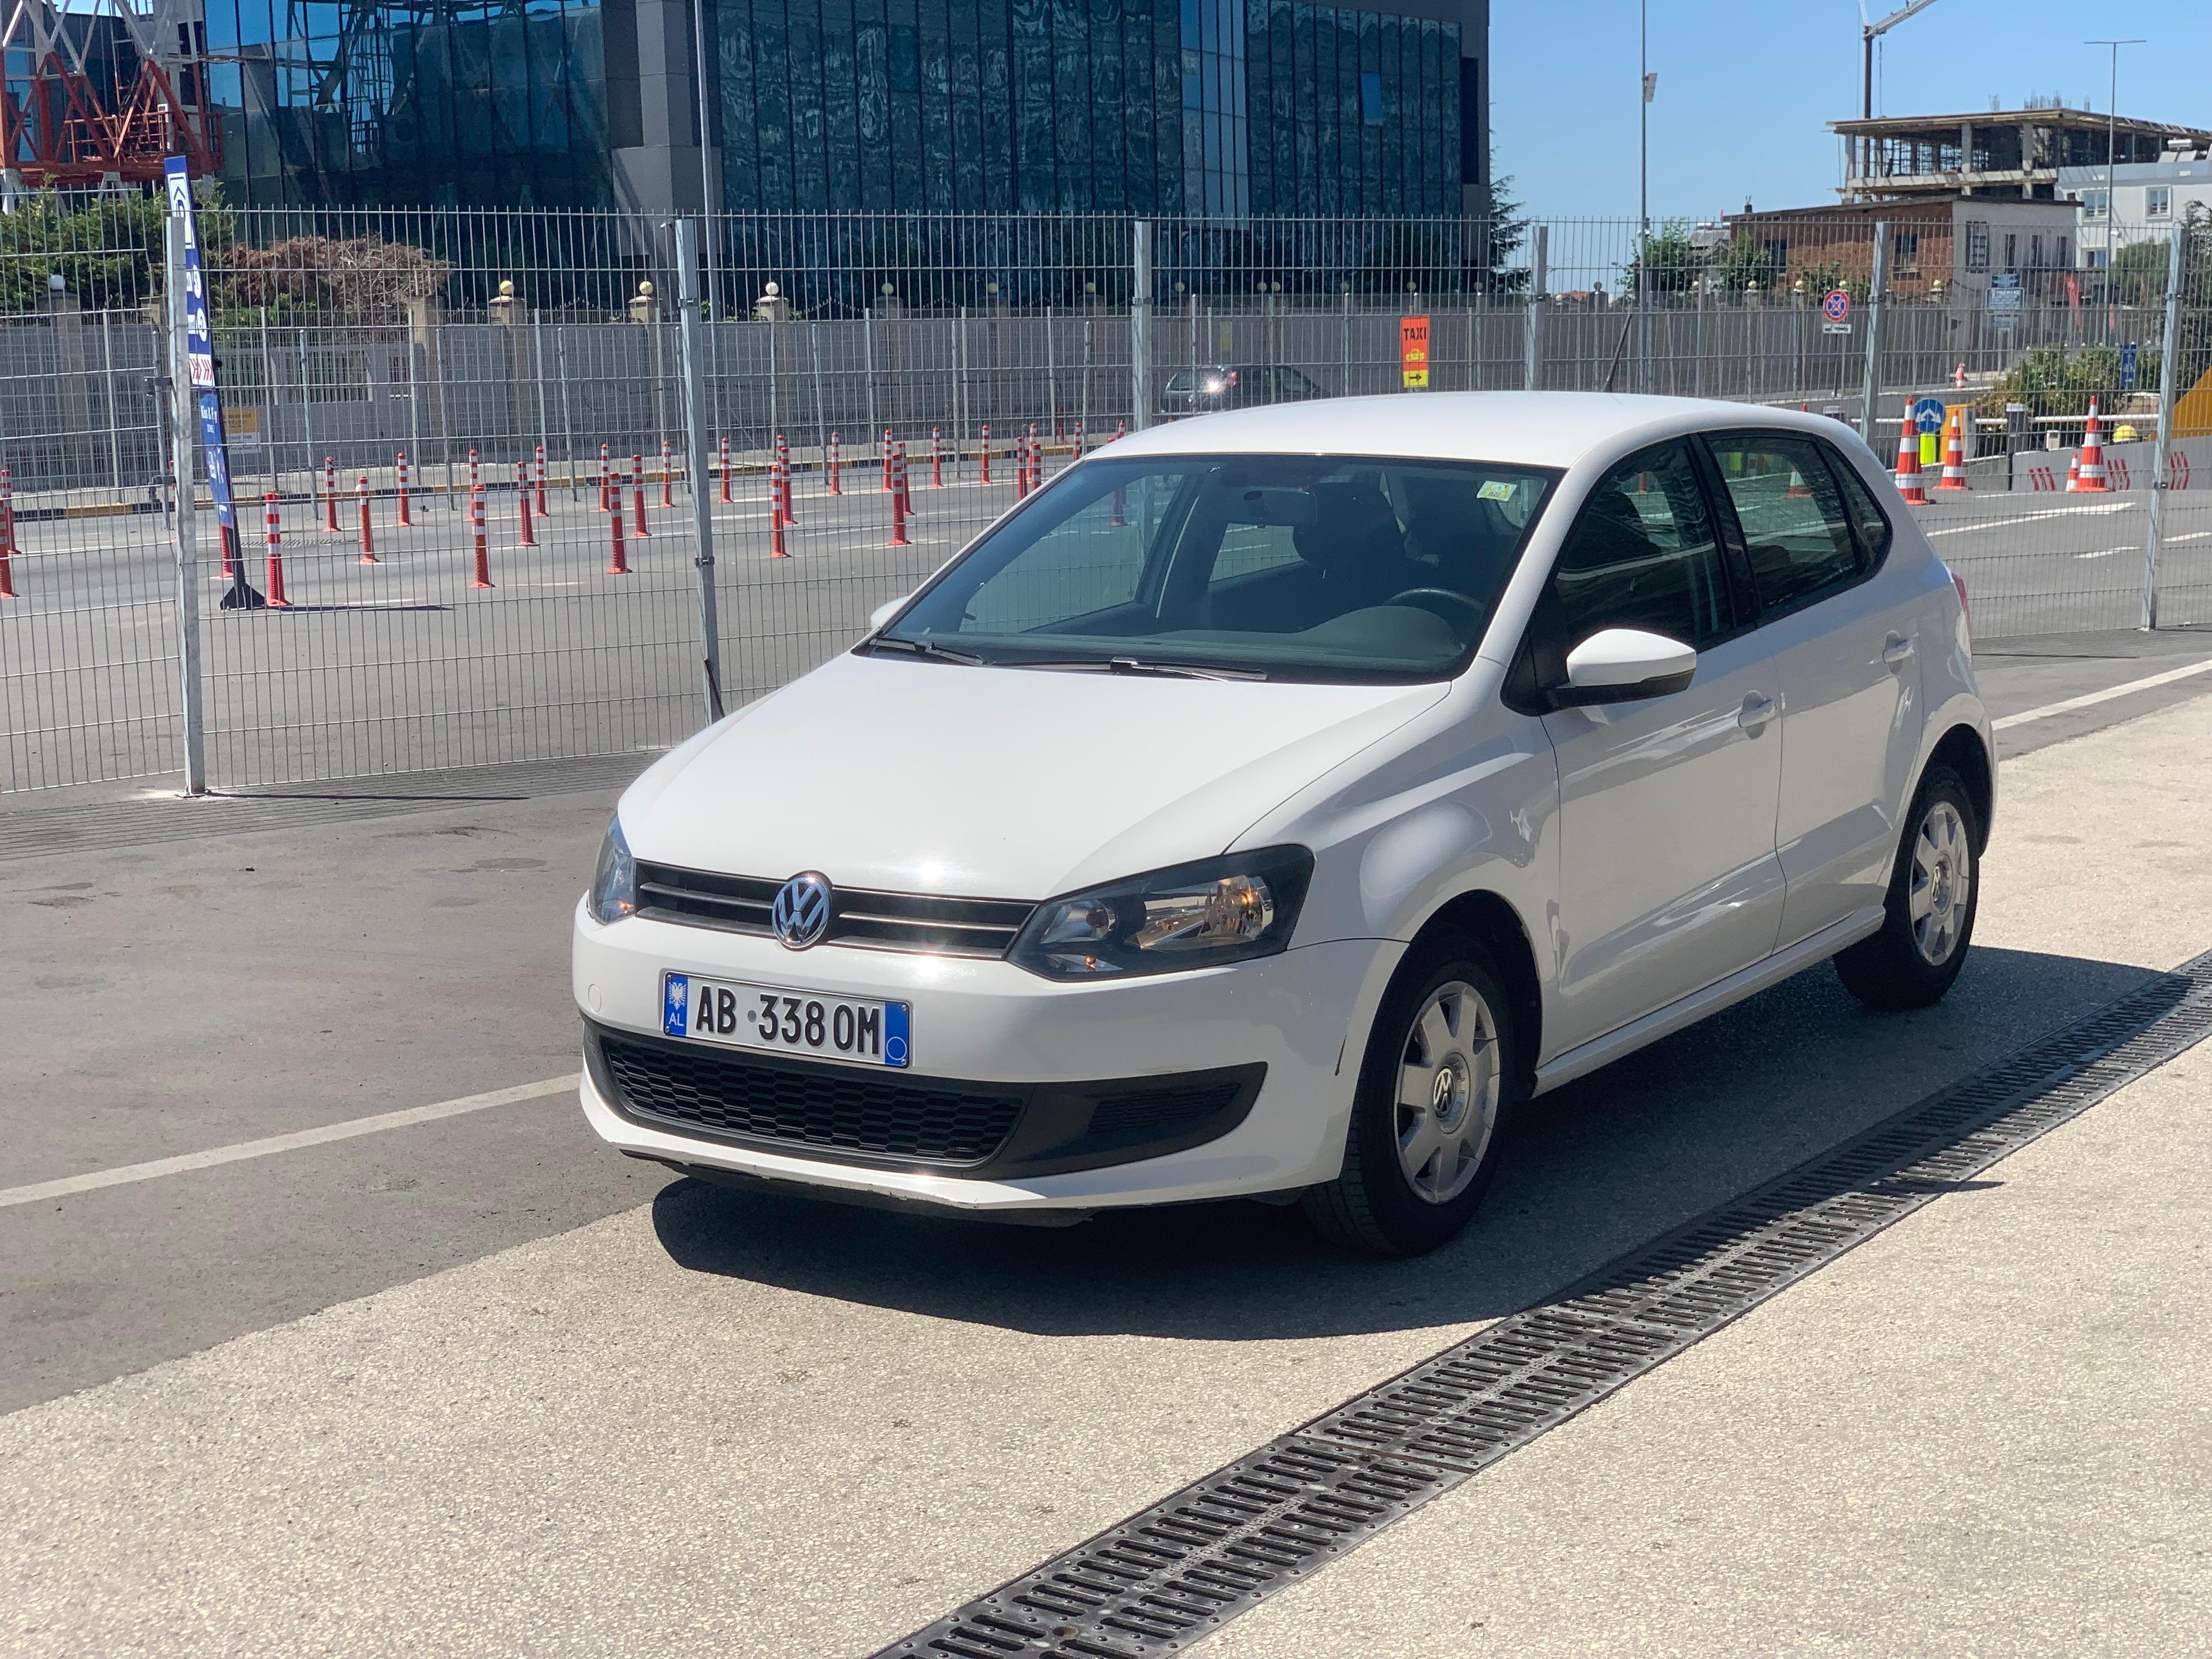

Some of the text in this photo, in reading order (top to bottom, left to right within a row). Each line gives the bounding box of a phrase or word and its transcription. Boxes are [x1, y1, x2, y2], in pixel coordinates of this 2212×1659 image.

[1403, 327, 1427, 340] TAXI
[696, 985, 737, 1034] AB
[669, 1013, 684, 1027] AL
